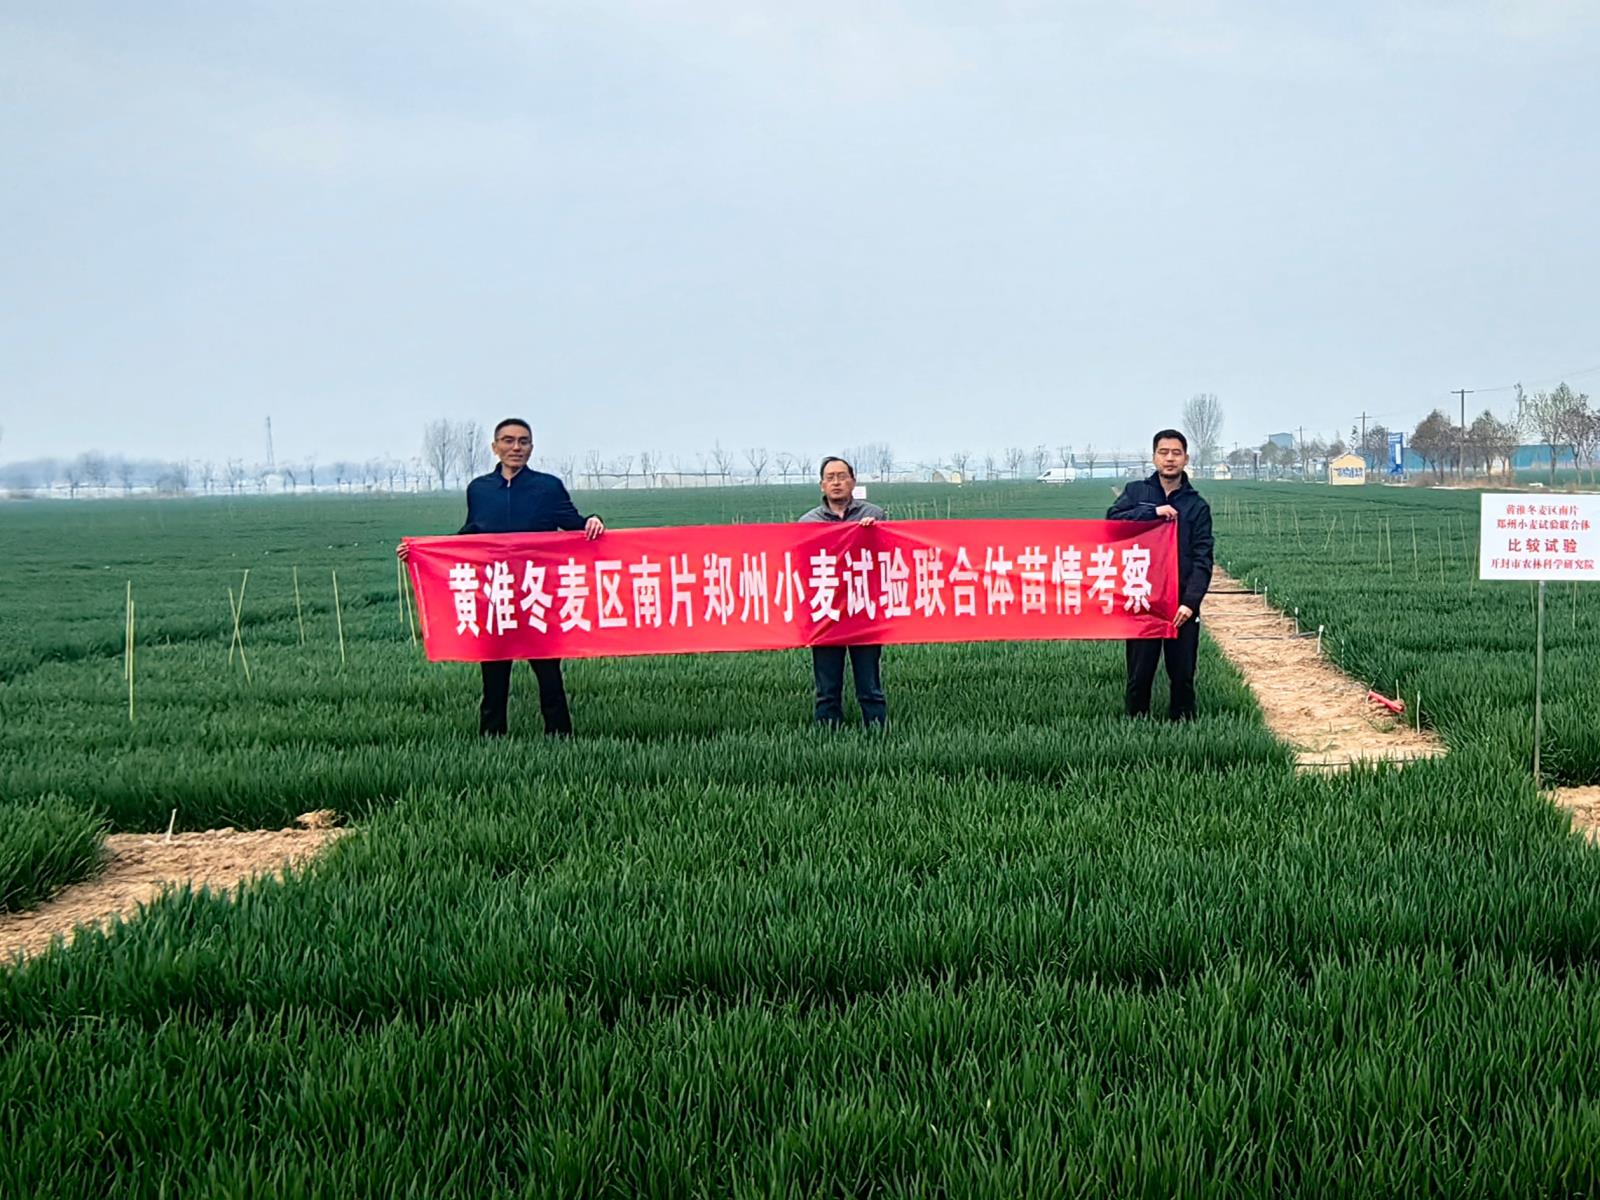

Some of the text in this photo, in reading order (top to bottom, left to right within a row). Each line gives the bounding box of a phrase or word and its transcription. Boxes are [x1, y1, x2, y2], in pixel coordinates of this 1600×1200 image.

[1497, 518, 1590, 531] 郑州小麦试验联合体
[1508, 537, 1577, 553] 比较试验
[1491, 558, 1595, 570] 开封市农林科学研究院
[449, 543, 1152, 637] 黄淮冬麦区南片郑州小麦试验联合体苗情考察
